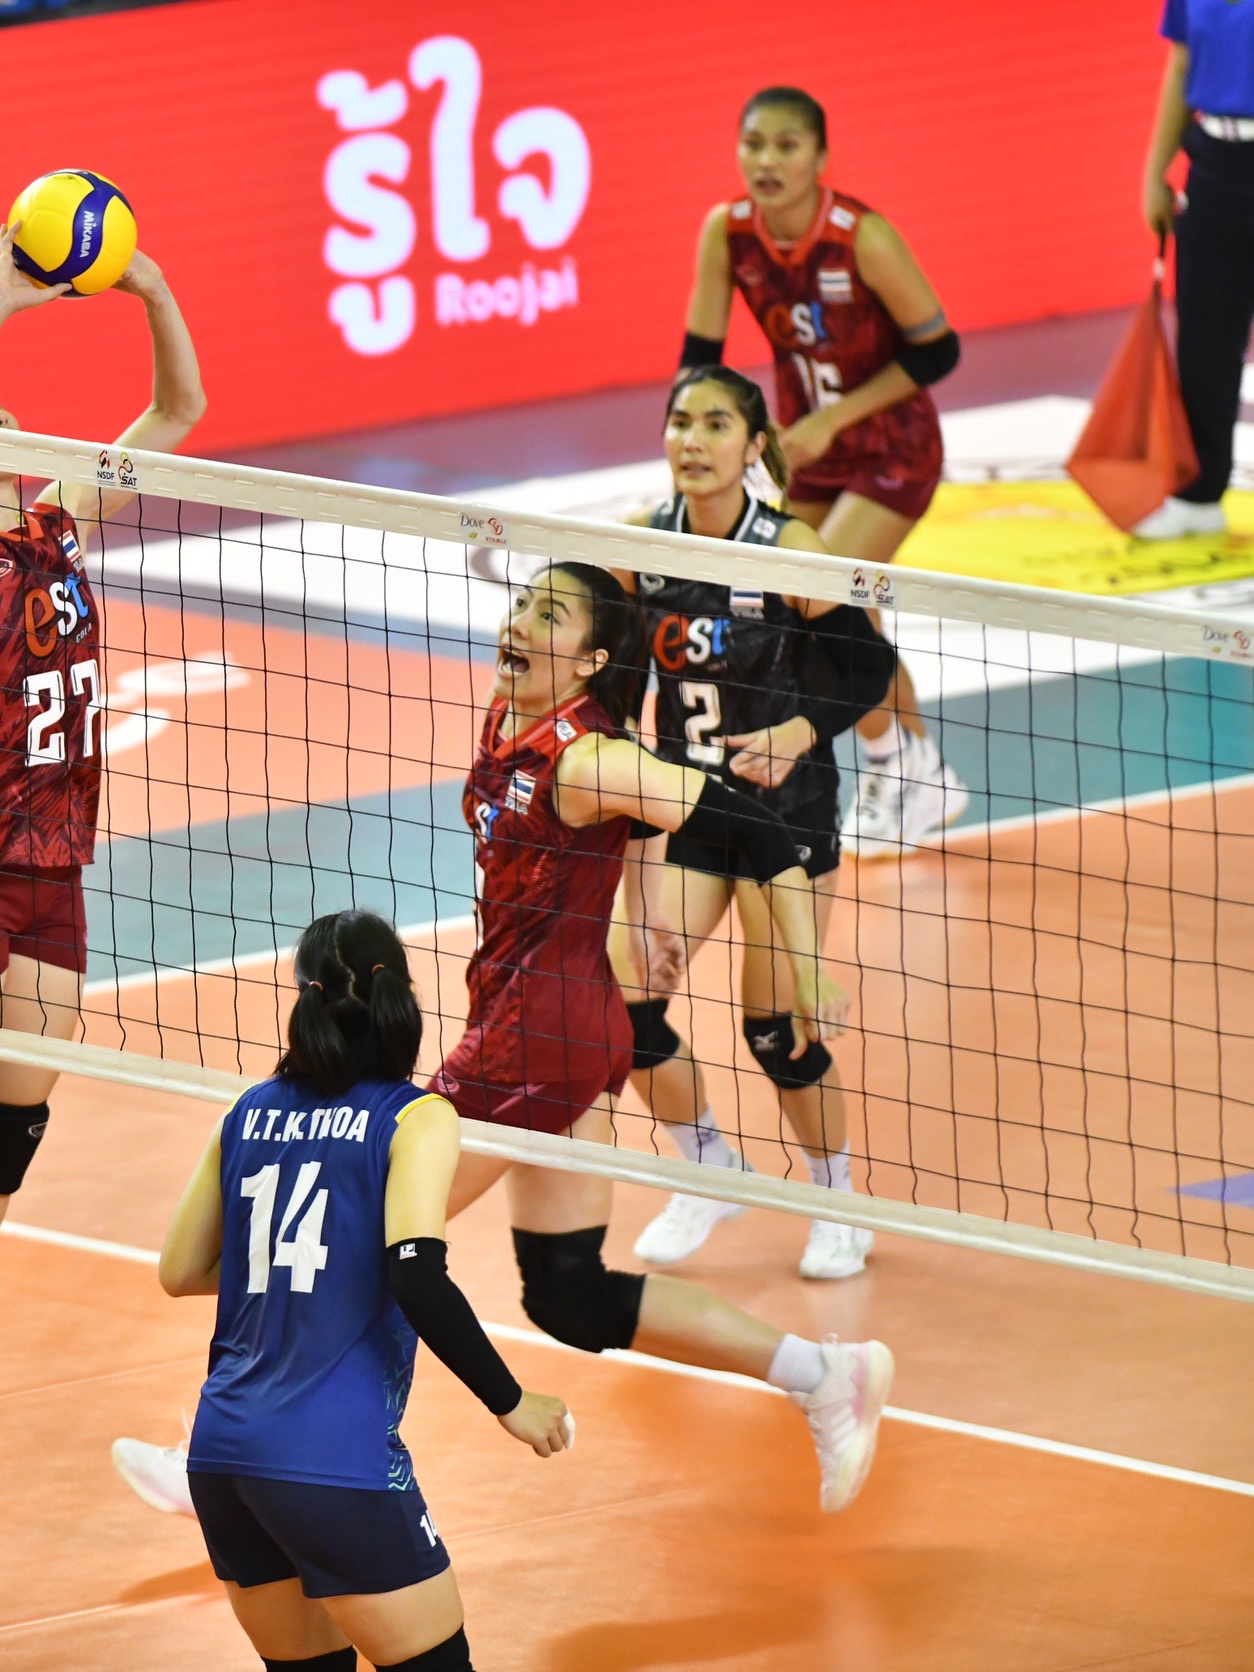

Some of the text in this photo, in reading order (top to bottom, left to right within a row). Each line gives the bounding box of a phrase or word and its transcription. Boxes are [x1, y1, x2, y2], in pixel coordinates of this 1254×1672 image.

[434, 255, 578, 327] Roojai
[97, 471, 115, 480] NSDF
[120, 476, 138, 486] SAT
[460, 512, 485, 528] Dove
[25, 573, 89, 657] est
[75, 622, 93, 644] COLA
[653, 614, 731, 671] est
[23, 659, 101, 767] 27
[680, 681, 725, 765] 2
[240, 1161, 329, 1293] 14
